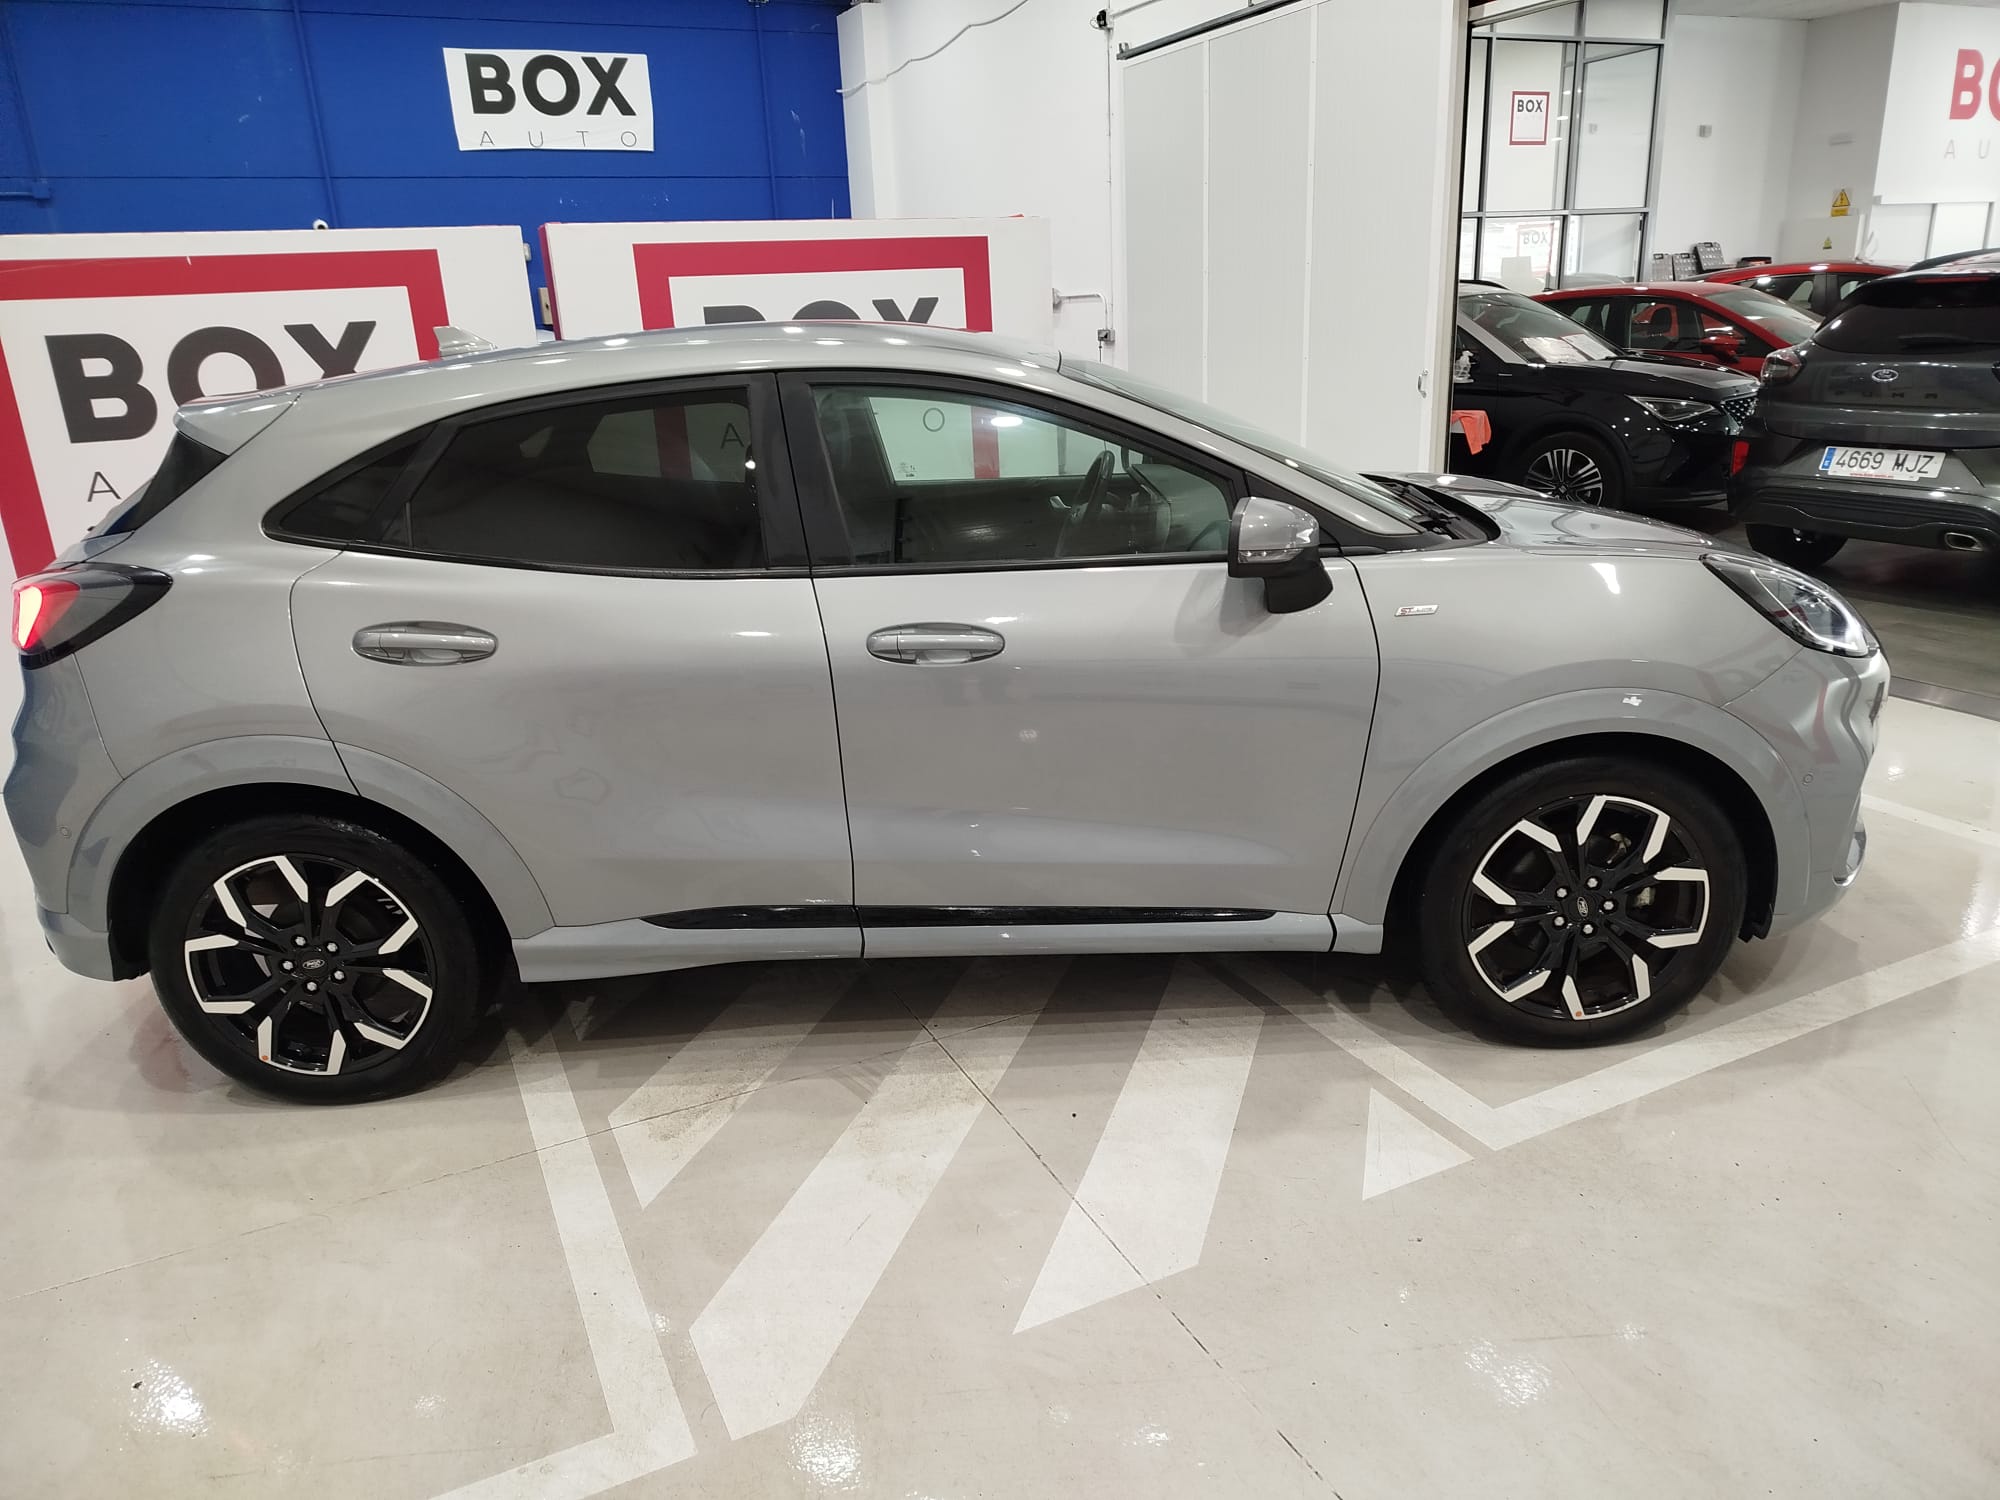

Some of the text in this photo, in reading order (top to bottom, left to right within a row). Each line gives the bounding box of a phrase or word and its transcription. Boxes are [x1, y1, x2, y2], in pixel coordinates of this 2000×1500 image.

[465, 53, 637, 116] BOX
[1948, 48, 2000, 122] B
[1517, 99, 1543, 112] BOX
[480, 130, 637, 147] AUTO
[1835, 450, 1935, 474] 4669 MJZ
